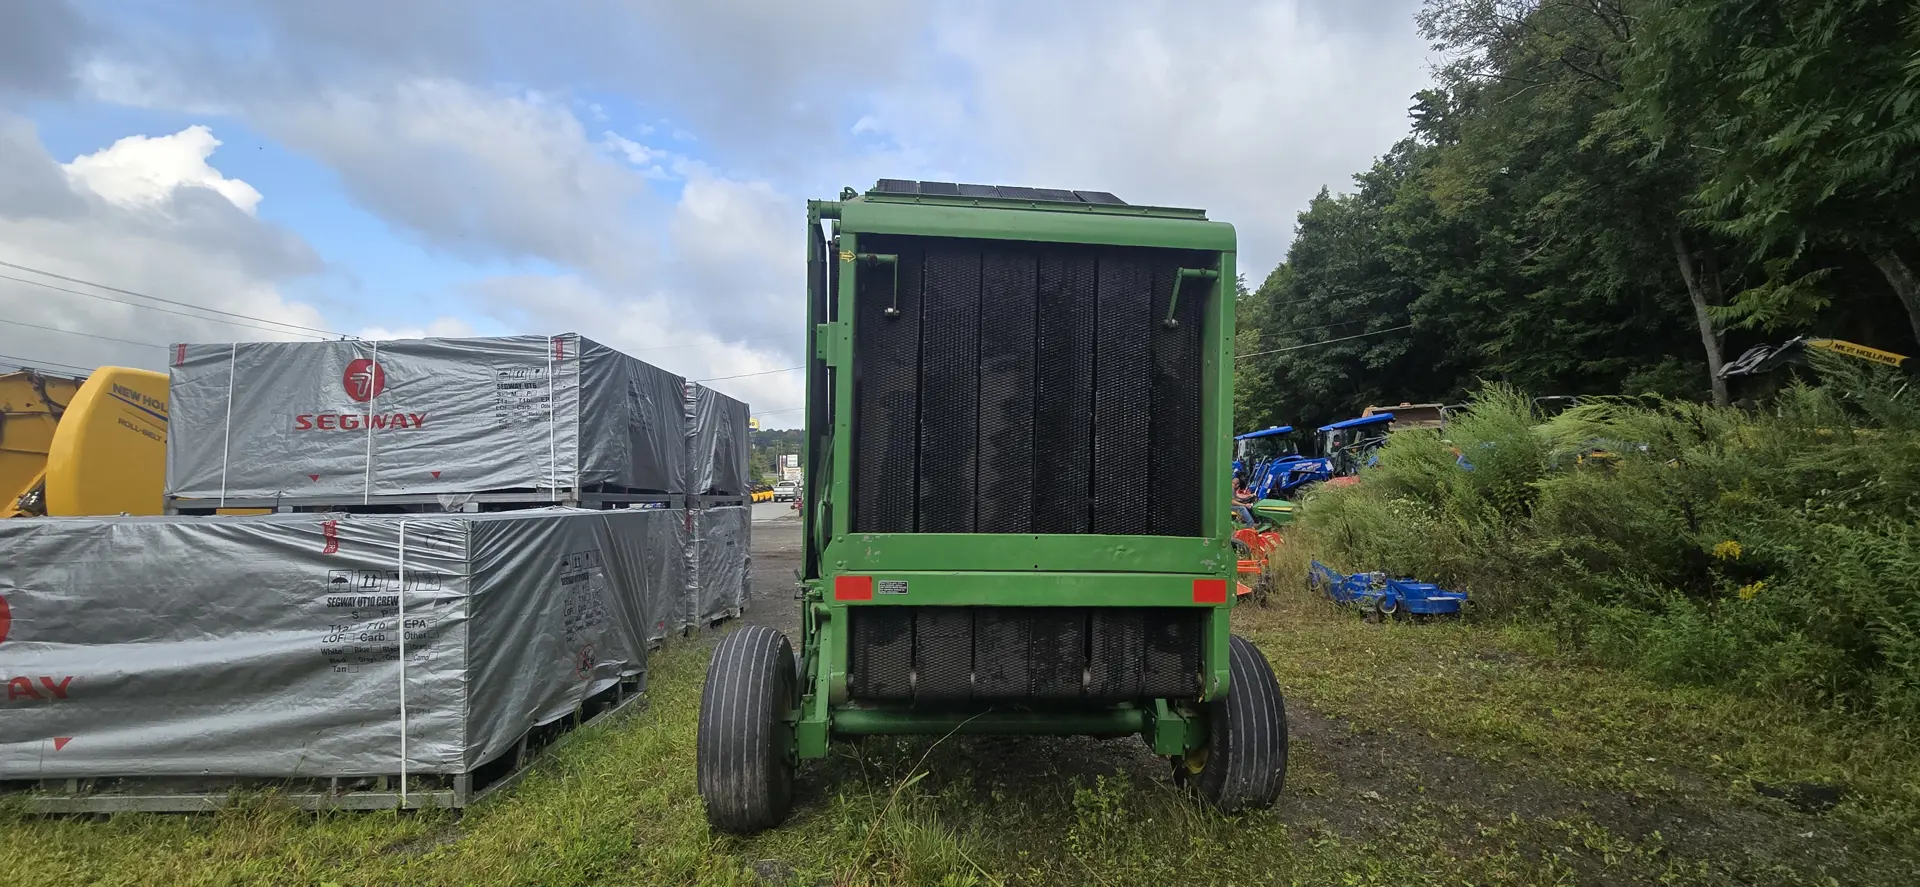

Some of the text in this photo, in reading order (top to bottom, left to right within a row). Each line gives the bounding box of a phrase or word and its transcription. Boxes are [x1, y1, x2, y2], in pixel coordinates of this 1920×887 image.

[1834, 343, 1897, 364] NEW HOLLAND
[112, 383, 141, 402] NEW
[295, 412, 428, 431] SEGWAY
[118, 418, 162, 442] ROLL-BELT
[327, 595, 400, 608] SEGWAY UT10 CREW
[351, 610, 389, 620] S P
[404, 619, 426, 629] EPA
[322, 631, 427, 643] LOF Carb Other
[320, 647, 342, 656] White
[332, 665, 347, 673] Tan
